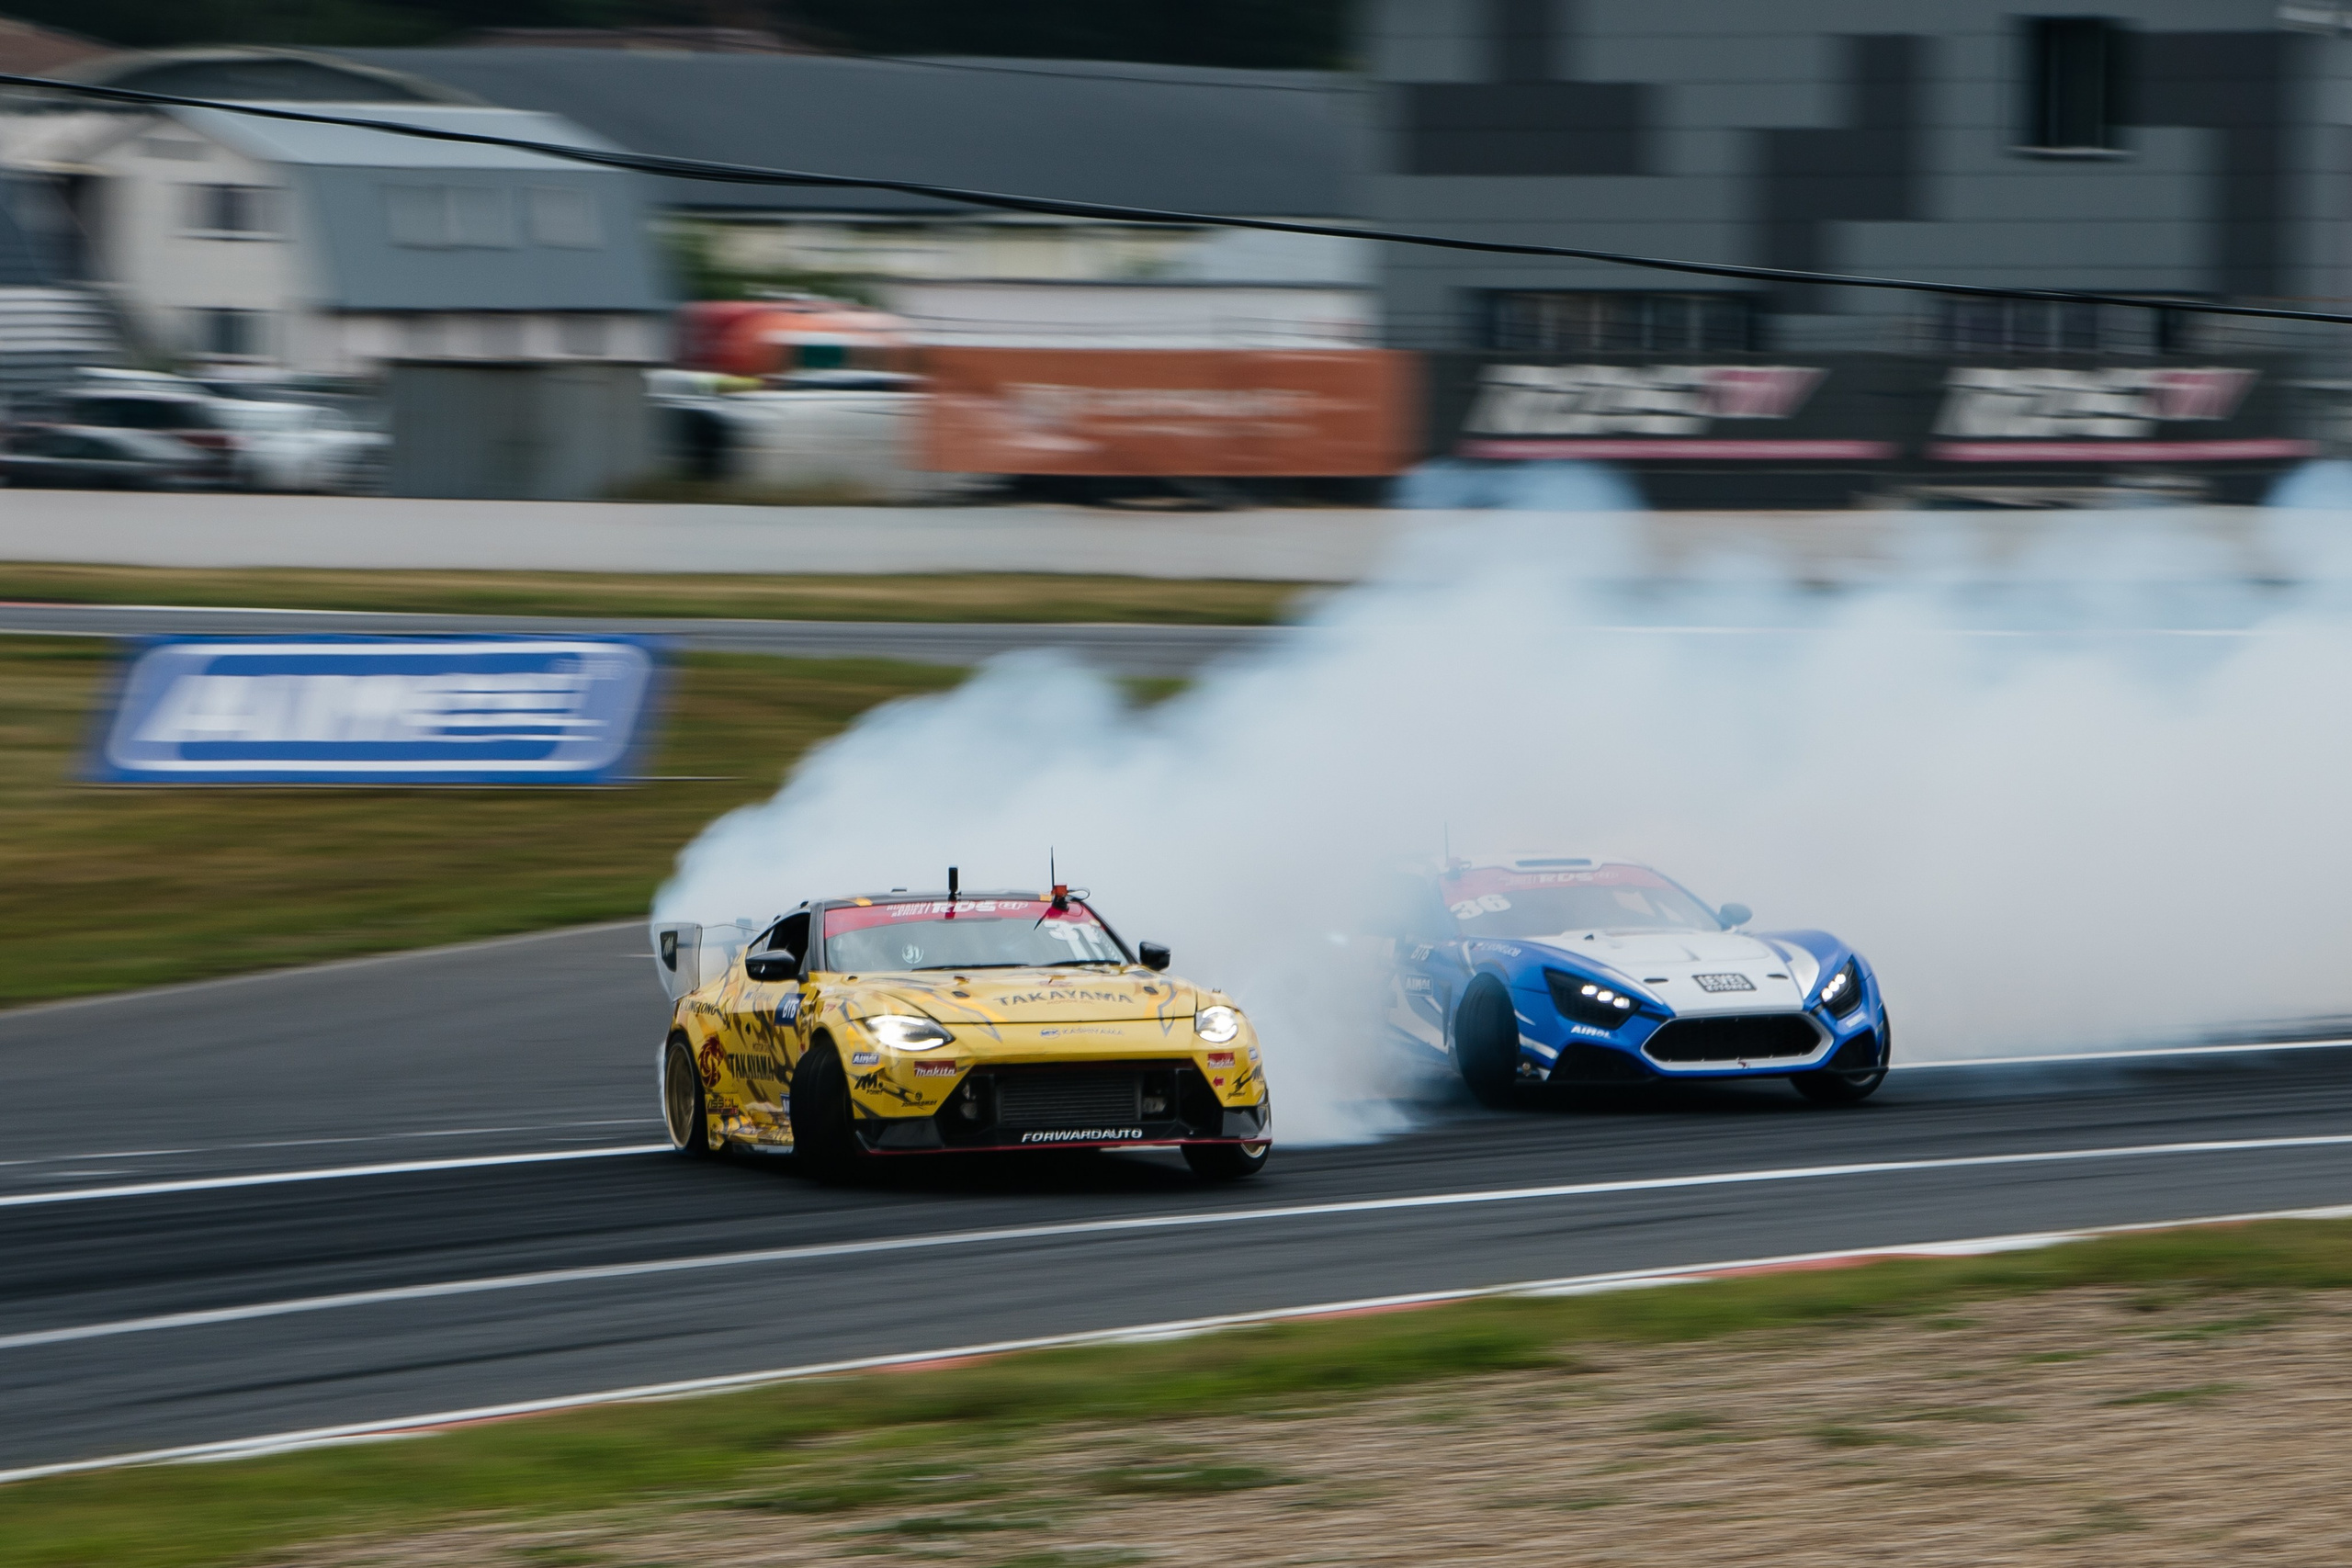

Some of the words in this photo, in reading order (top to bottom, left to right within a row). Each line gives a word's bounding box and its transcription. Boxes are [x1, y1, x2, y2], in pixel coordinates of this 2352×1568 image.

[1450, 895, 1511, 919] 36
[993, 990, 1134, 1006] TAKAYAMA
[1022, 1128, 1142, 1142] FORWARDAUTO
